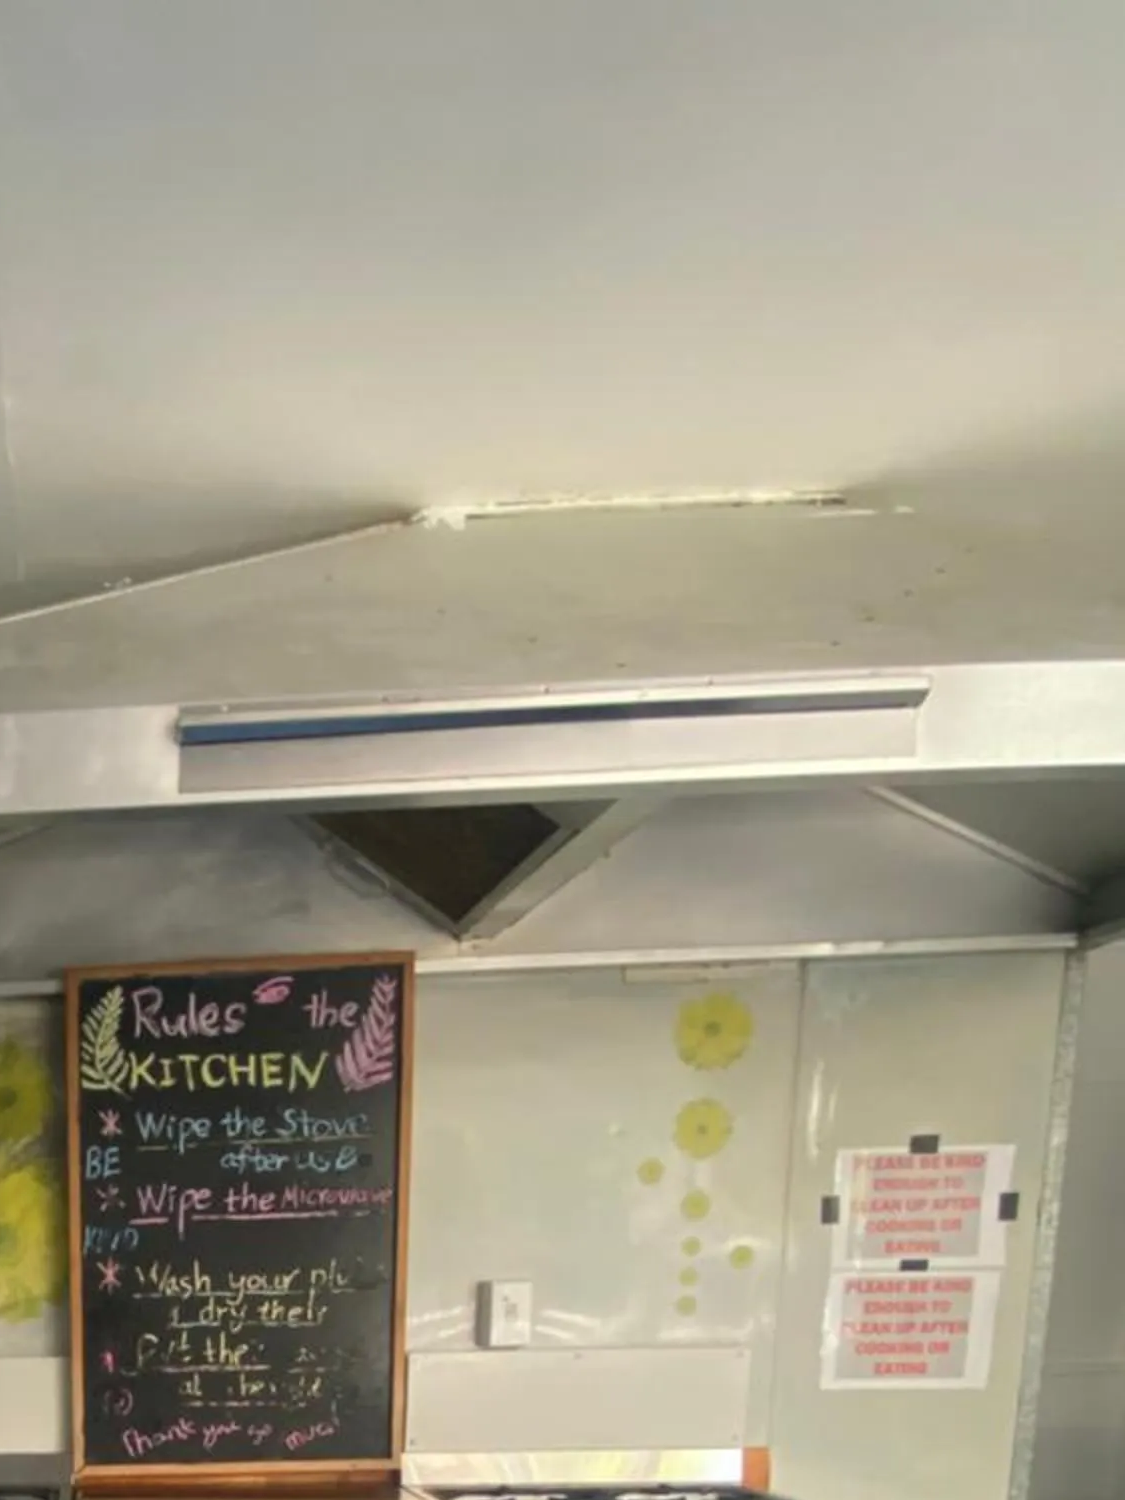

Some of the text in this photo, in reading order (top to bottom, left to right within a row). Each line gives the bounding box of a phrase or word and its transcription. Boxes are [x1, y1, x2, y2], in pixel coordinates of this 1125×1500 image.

[131, 986, 359, 1038] Rules the
[127, 1052, 329, 1092] KITCHEN
[135, 1111, 212, 1154] Wipe
[220, 1106, 267, 1138] the
[85, 1146, 121, 1179] BE
[220, 1144, 289, 1174] after
[919, 1155, 941, 1169] BE
[136, 1183, 213, 1241] Wipe
[224, 1181, 277, 1212] the
[906, 1198, 928, 1211] UP
[228, 1267, 301, 1305] your
[908, 1280, 928, 1293] BE
[896, 1321, 916, 1333] UP
